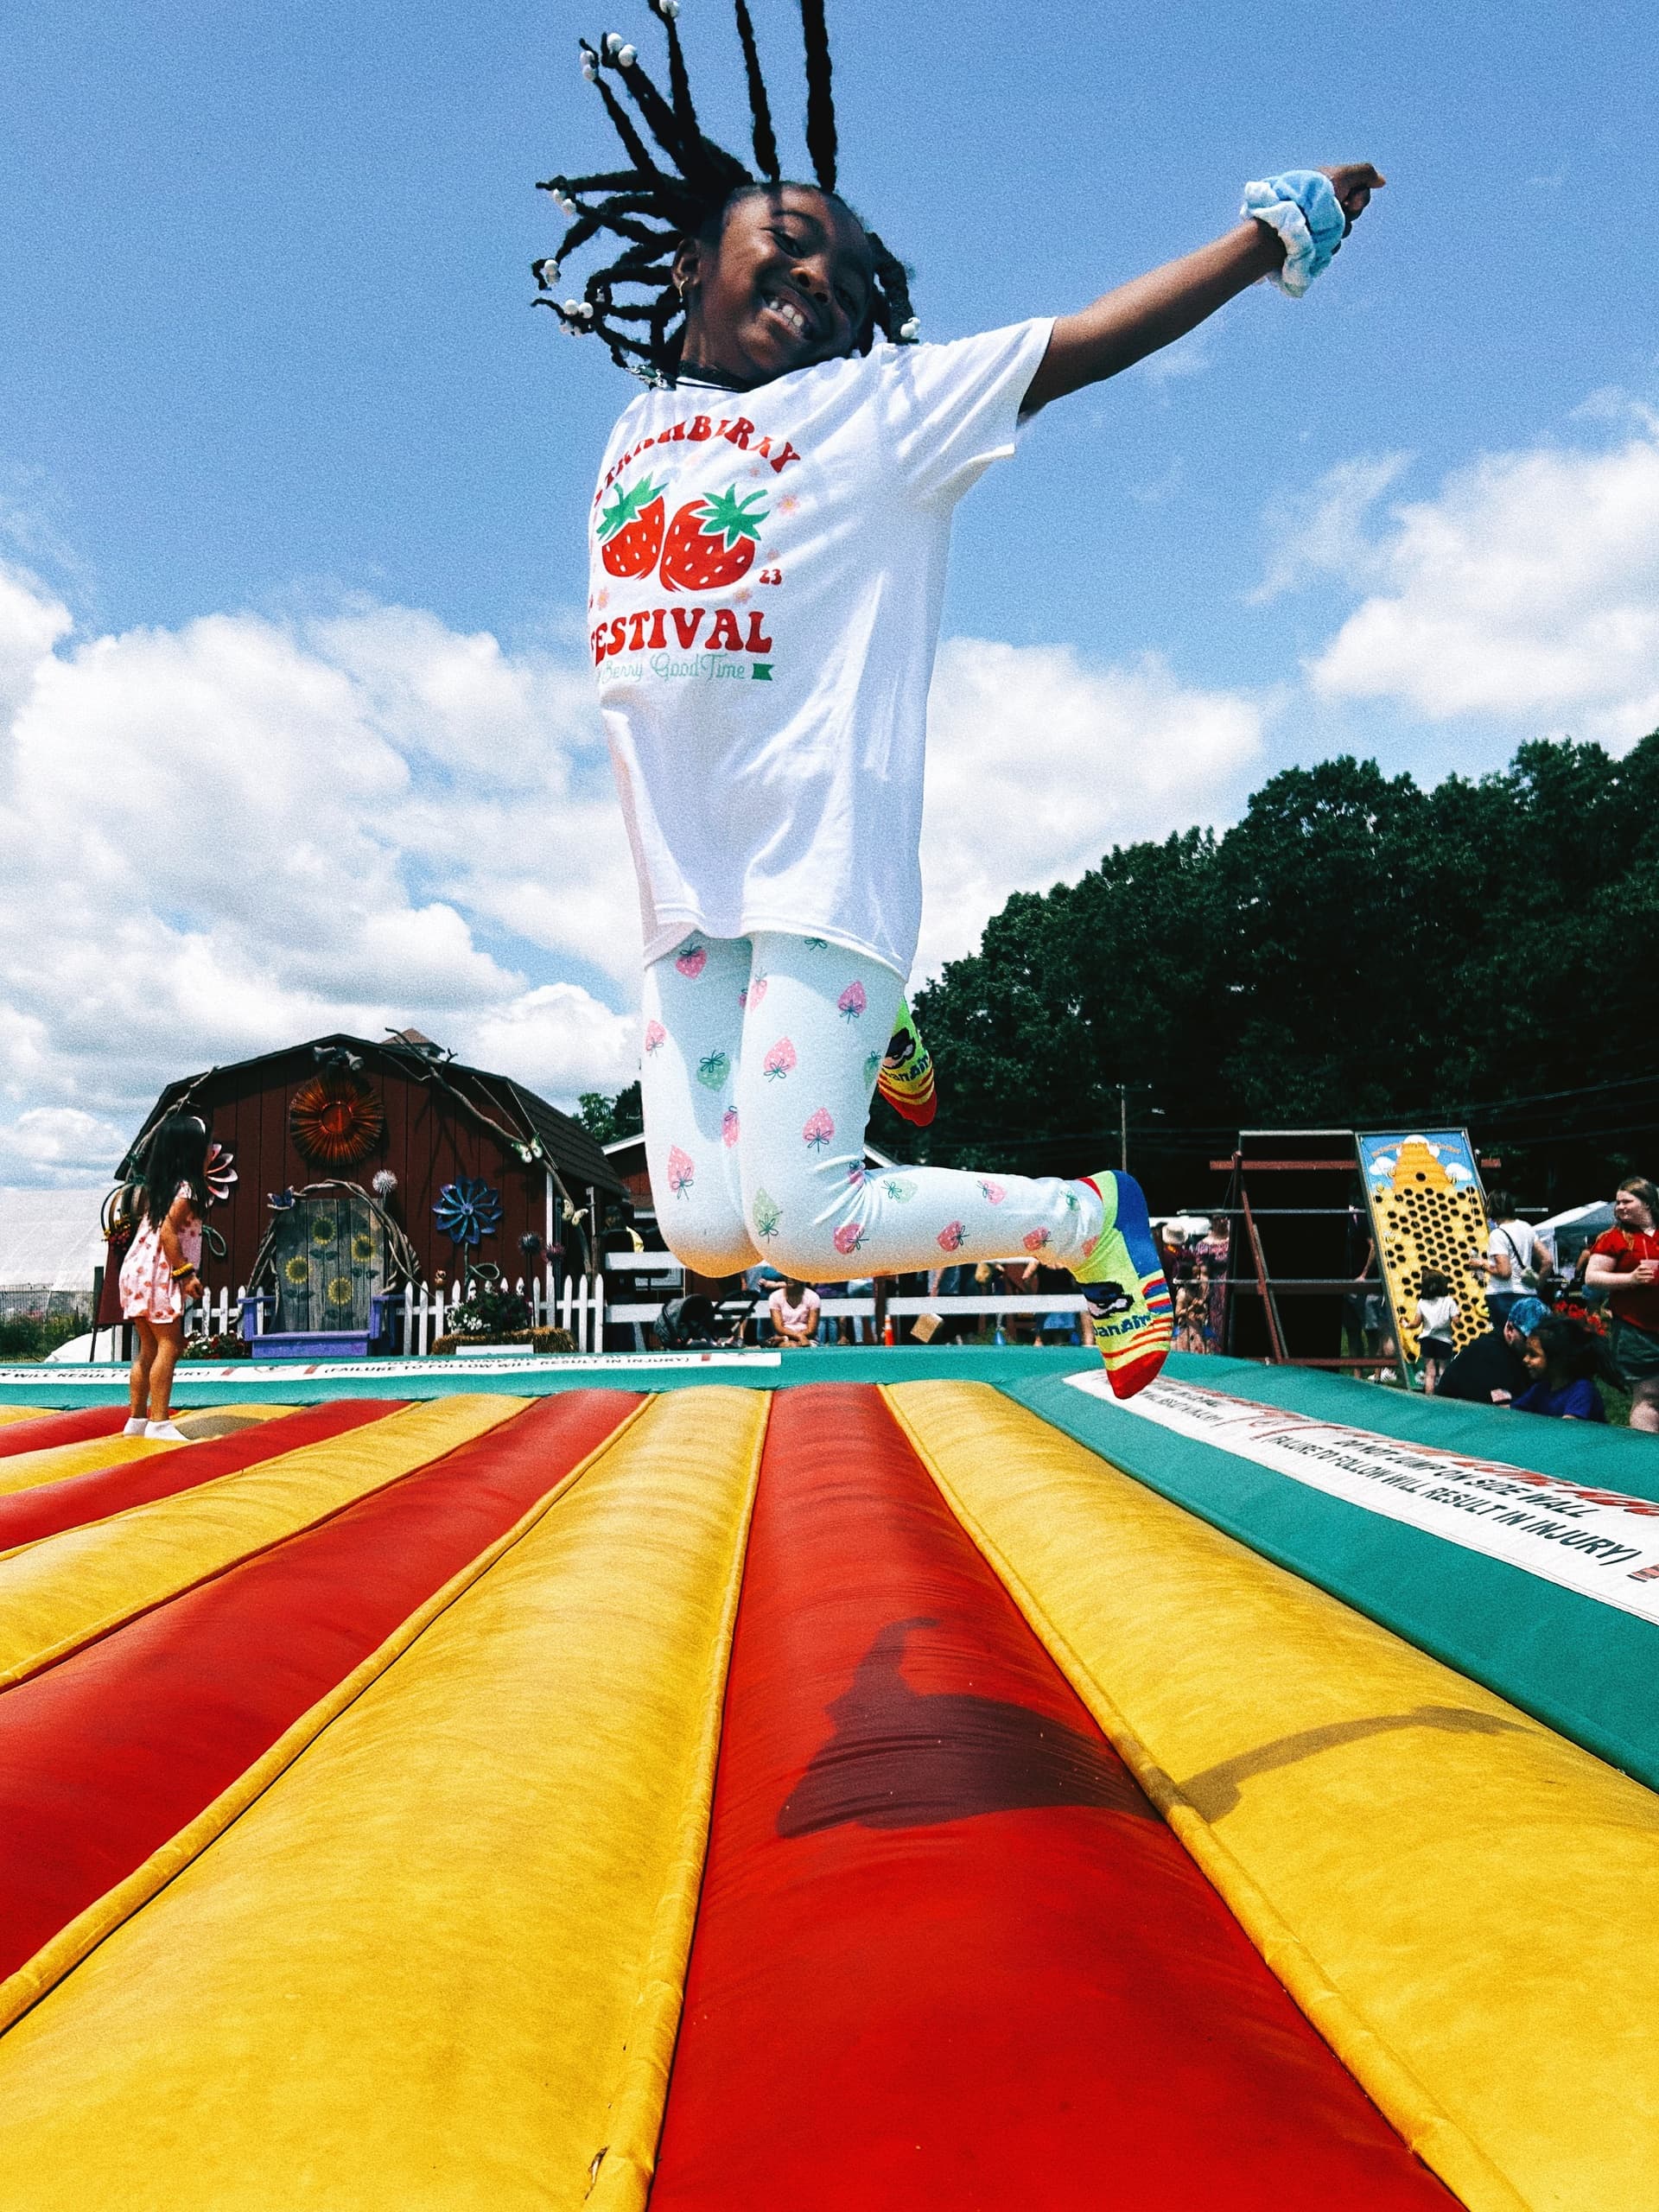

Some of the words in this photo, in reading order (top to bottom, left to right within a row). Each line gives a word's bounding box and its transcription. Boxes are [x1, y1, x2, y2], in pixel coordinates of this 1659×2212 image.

[760, 569, 782, 586] 23
[650, 652, 698, 682] Good
[700, 653, 746, 681] Time
[1311, 1449, 1339, 1460] TO
[1327, 1455, 1391, 1480] FOLLOW
[1382, 1471, 1431, 1493] WILL
[1420, 1487, 1509, 1516] RESULT
[1491, 1510, 1536, 1527] IN
[1520, 1520, 1643, 1567] INJURY)
[1433, 1470, 1480, 1481] ON
[1463, 1478, 1532, 1496] SIDE
[1516, 1493, 1600, 1518] WALL
